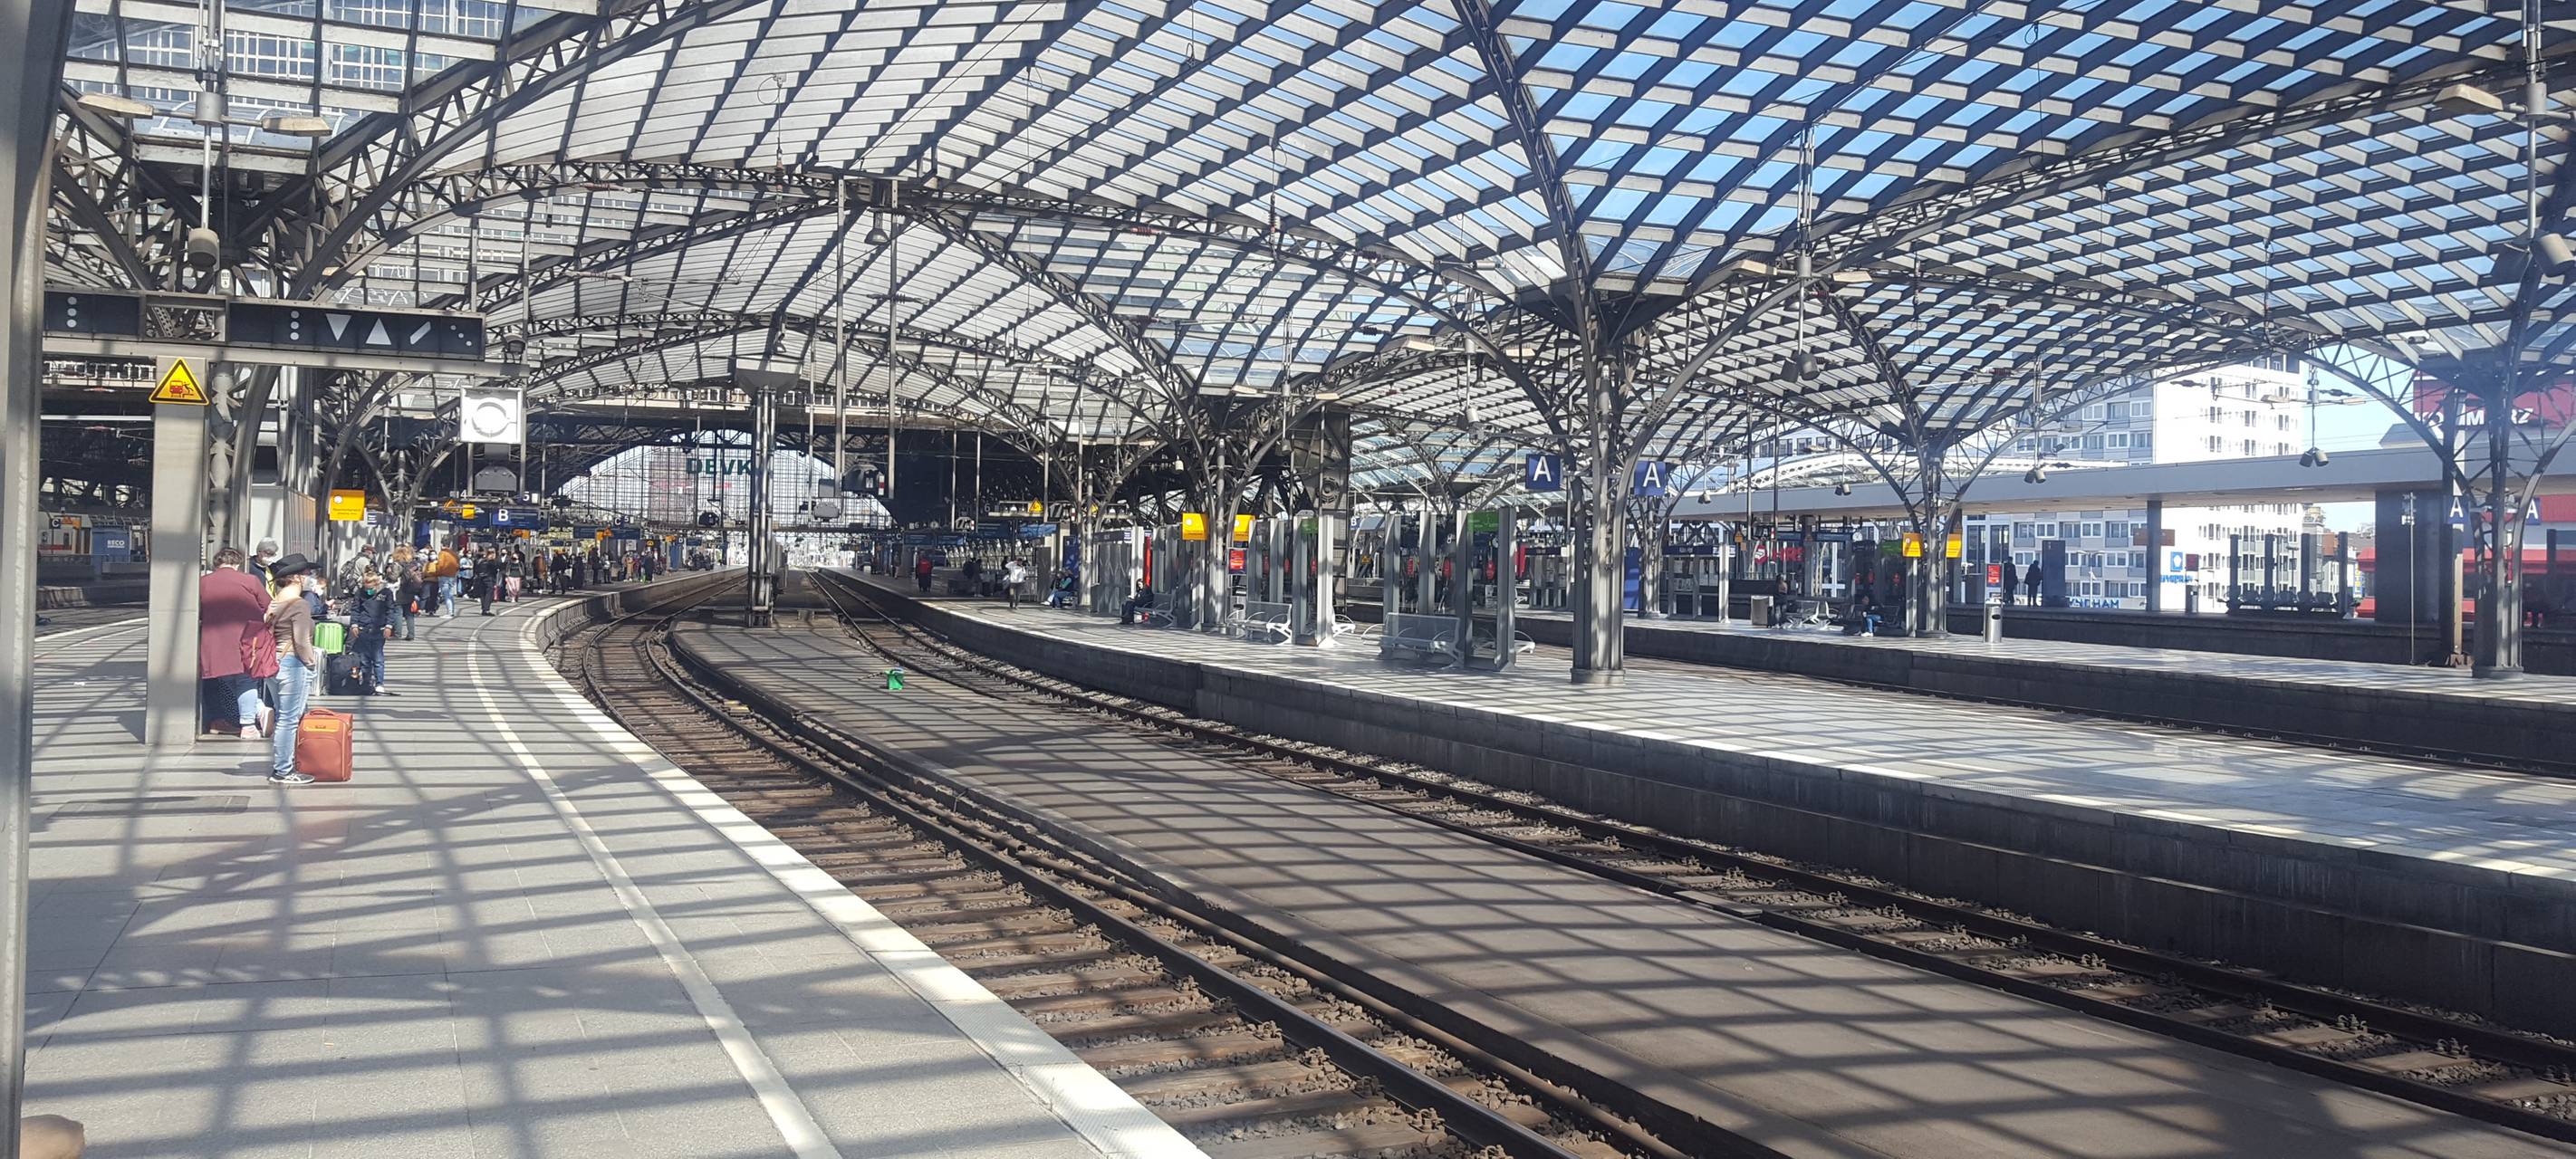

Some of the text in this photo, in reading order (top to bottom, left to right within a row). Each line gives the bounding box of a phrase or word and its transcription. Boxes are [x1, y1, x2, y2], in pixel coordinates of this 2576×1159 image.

[686, 458, 753, 475] DEVK
[1533, 455, 1552, 483] A
[1643, 462, 1661, 488] A
[460, 490, 467, 499] 4
[523, 492, 529, 501] 5
[984, 503, 991, 512] 6
[2449, 496, 2464, 518] A
[2525, 499, 2539, 520] A
[498, 509, 508, 522] B
[615, 518, 621, 526] C
[52, 519, 60, 527] C
